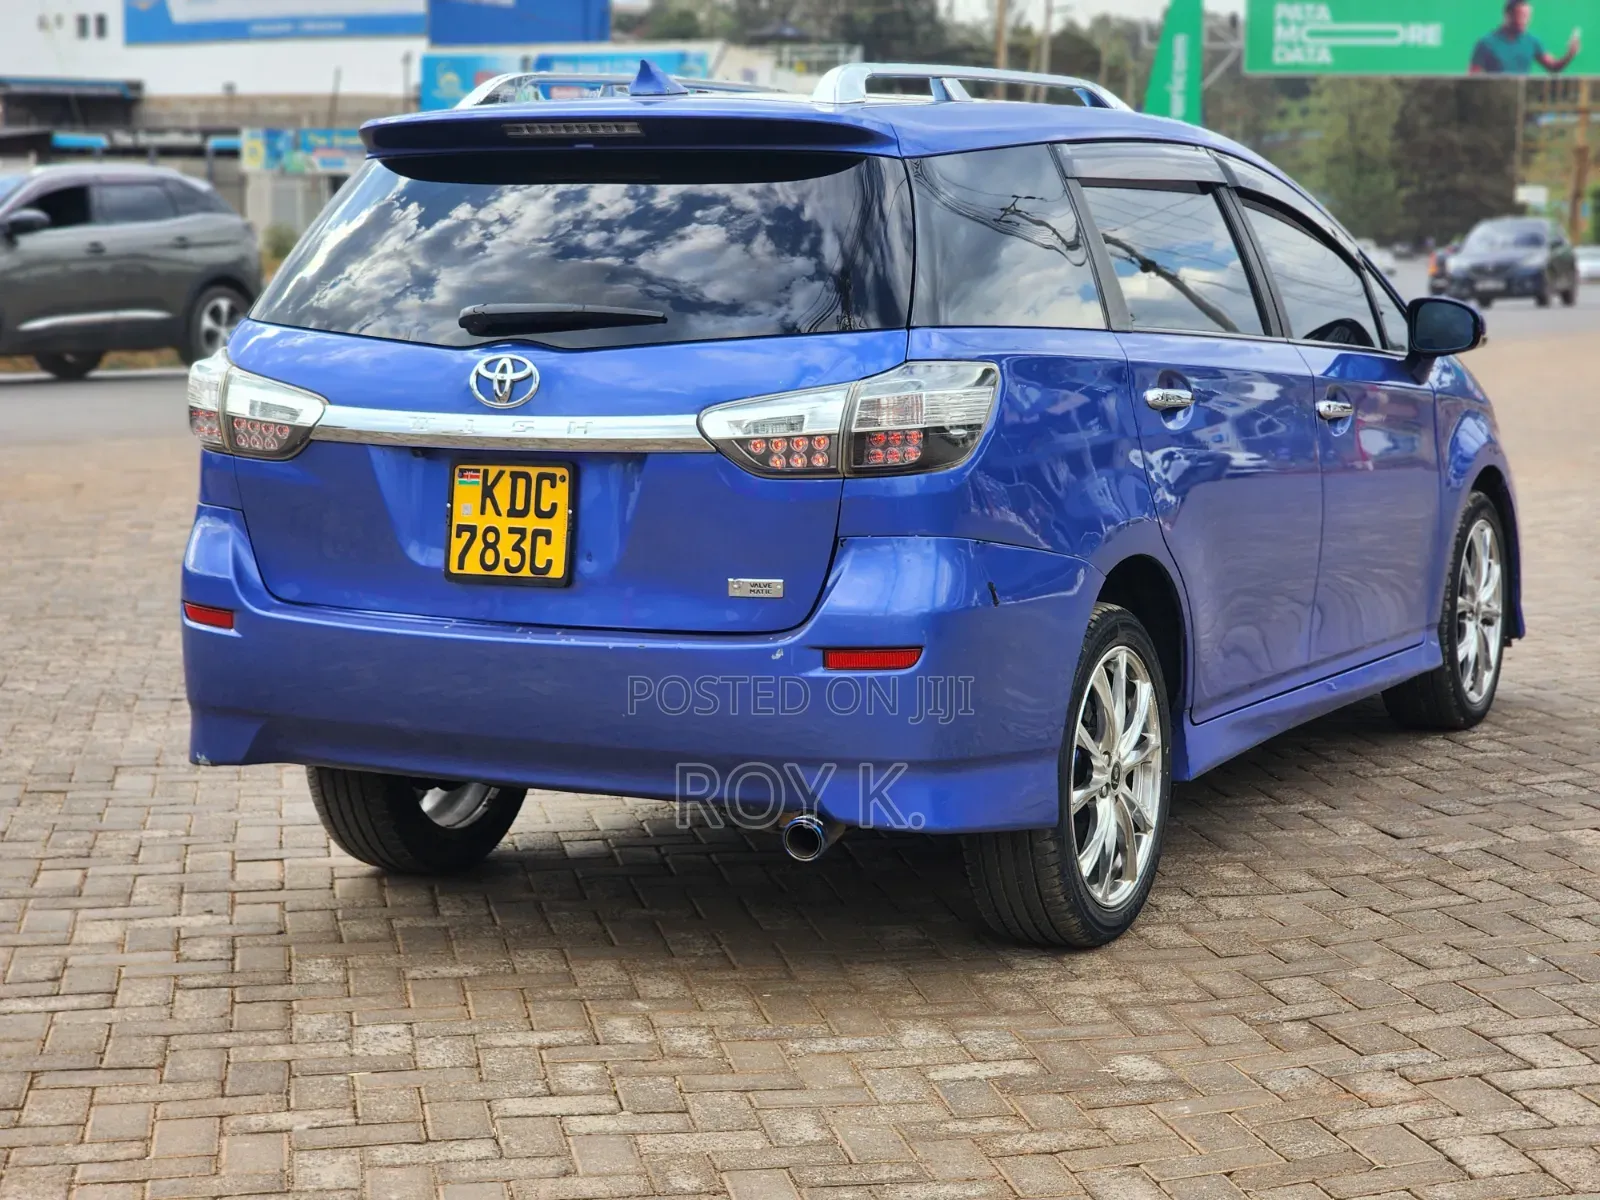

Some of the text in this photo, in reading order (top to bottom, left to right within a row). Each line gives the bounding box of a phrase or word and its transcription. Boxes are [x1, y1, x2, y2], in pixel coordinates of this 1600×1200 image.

[1273, 46, 1333, 64] DATA
[480, 468, 558, 519] KDC
[455, 523, 553, 576] 783C
